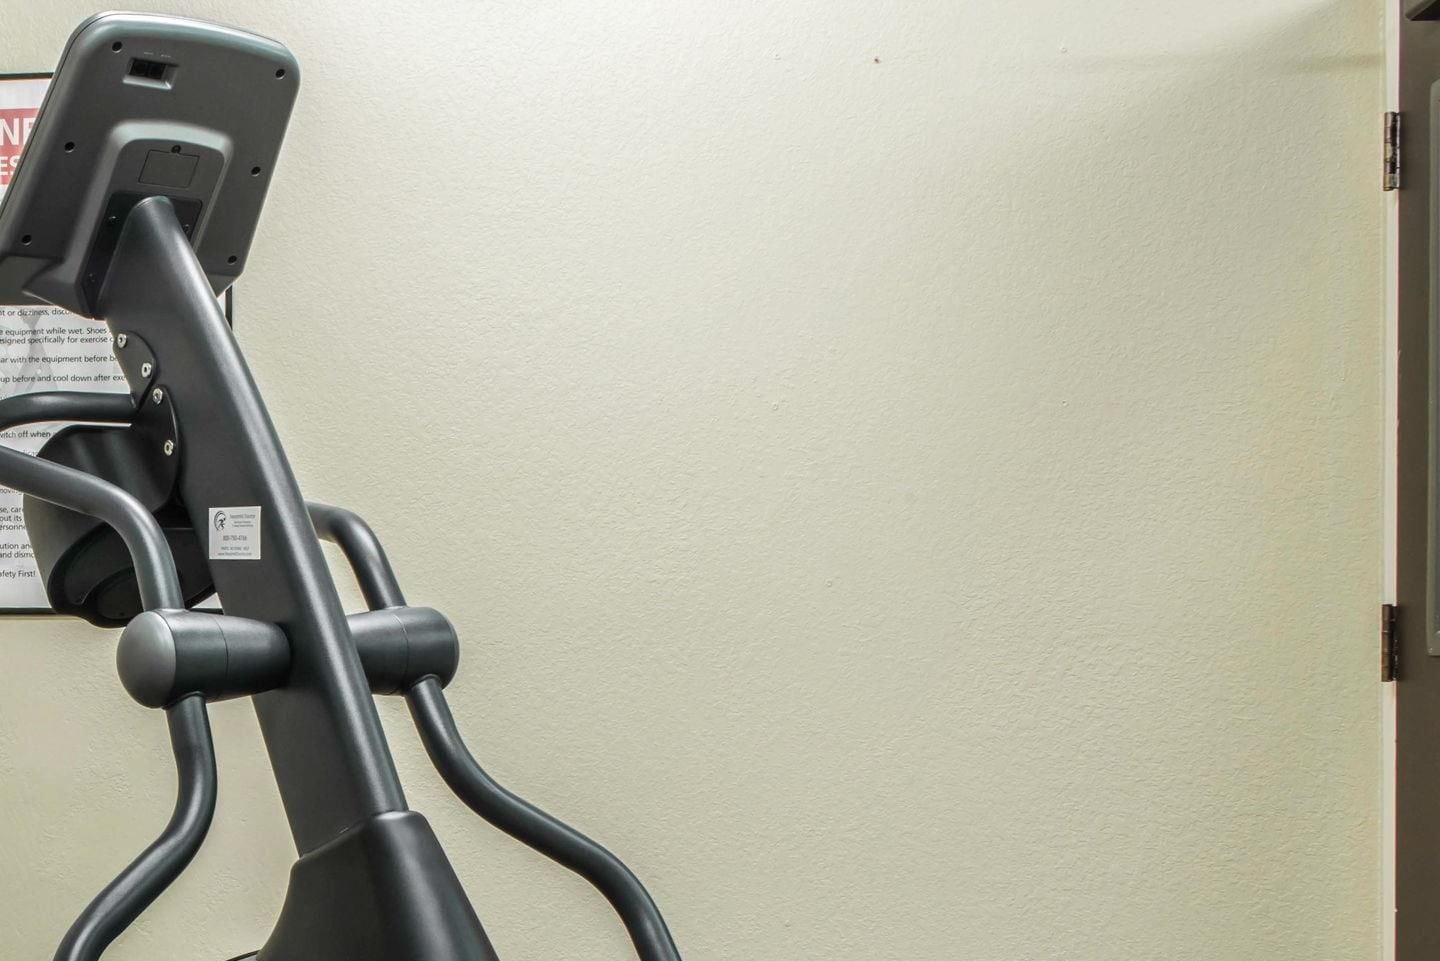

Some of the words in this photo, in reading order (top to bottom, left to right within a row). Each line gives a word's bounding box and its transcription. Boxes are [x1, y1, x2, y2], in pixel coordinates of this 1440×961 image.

[17, 307, 50, 318] dizziness,
[5, 328, 44, 337] equipment
[46, 327, 67, 335] while
[86, 327, 107, 335] Shoes
[27, 336, 66, 345] specifically
[67, 336, 78, 344] for
[79, 336, 108, 344] exercise
[9, 356, 27, 364] with
[28, 356, 41, 364] the
[42, 355, 83, 364] equipment
[84, 355, 108, 363] before
[0, 376, 10, 385] up
[12, 375, 36, 383] before
[37, 375, 51, 383] and
[52, 374, 69, 382] cool
[70, 374, 92, 382] down
[93, 374, 111, 382] after
[18, 430, 28, 438] off
[30, 430, 51, 438] when
[17, 570, 36, 578] First!
